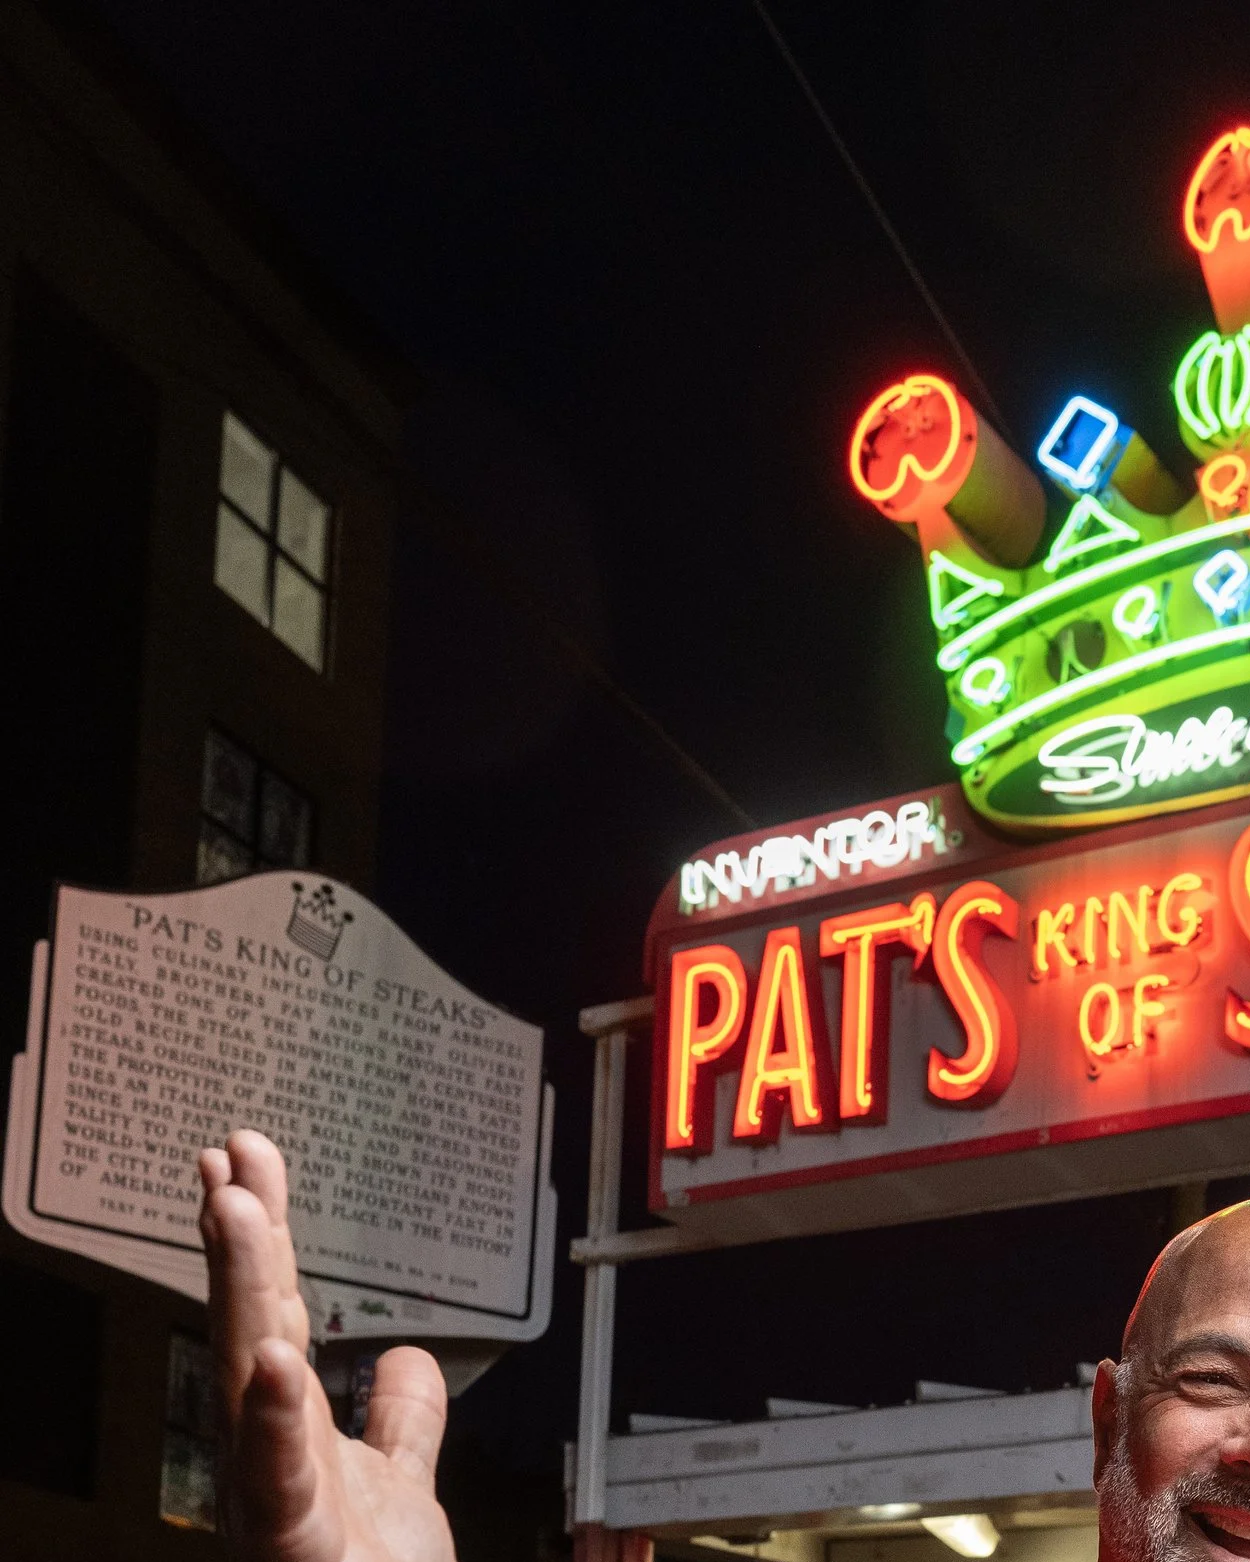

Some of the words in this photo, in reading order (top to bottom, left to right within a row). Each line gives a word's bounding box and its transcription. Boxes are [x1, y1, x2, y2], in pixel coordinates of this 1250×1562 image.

[680, 800, 942, 910] INVENTOR
[235, 934, 312, 981] KING
[322, 960, 363, 995] OF
[1035, 872, 1205, 973] KING
[75, 962, 165, 1001] CREATED
[175, 990, 214, 1015] ONE
[225, 1004, 249, 1024] OF
[261, 1014, 297, 1037] THE
[396, 1051, 475, 1086] FAVORITE
[484, 1076, 523, 1099] FAST
[79, 923, 138, 954] USING
[152, 943, 248, 984] CULINARY
[261, 974, 379, 1020] INFLUENCES
[391, 1010, 440, 1038] FROM
[156, 965, 265, 1009] BROTHERS
[280, 1000, 314, 1023] PAT
[326, 1013, 363, 1037] AND
[377, 1027, 434, 1057] HARRY
[448, 1047, 524, 1082] OLIVIERI
[665, 881, 1018, 1149] PAT'S
[1078, 974, 1170, 1056] OF
[70, 1023, 144, 1055] STEAKS
[153, 1043, 265, 1086] ORIGINATED
[274, 1074, 318, 1099] HERE
[329, 1088, 347, 1107] IN
[399, 1107, 431, 1128] AND
[439, 1117, 520, 1152] INVENTED
[134, 1018, 205, 1050] RECIPE
[218, 1040, 266, 1066] USED
[277, 1056, 296, 1074] IN
[307, 1064, 396, 1100] AMERICAN
[151, 1003, 187, 1026] THE
[197, 1015, 255, 1044] STEAK
[364, 1060, 411, 1086] FROM
[416, 1075, 427, 1090] A
[66, 1081, 122, 1109] SINCE
[319, 1142, 351, 1164] HAS
[361, 1153, 421, 1181] SHOWN
[430, 1170, 457, 1190] ITS
[67, 1060, 116, 1088] USES
[124, 1075, 148, 1096] AN
[310, 1121, 356, 1147] ROLL
[365, 1135, 399, 1157] AND
[69, 1041, 107, 1065] THE
[117, 1053, 224, 1095] PROTOTYPE
[232, 1082, 255, 1102] OF
[263, 1090, 364, 1129] BEEFSTEAK
[371, 1118, 471, 1156] SANDWICHES
[478, 1145, 518, 1168] THAT
[58, 1158, 87, 1179] OF
[100, 1167, 199, 1204] AMERICAN
[61, 1139, 99, 1163] THE
[107, 1150, 150, 1175] CITY
[159, 1163, 183, 1183] OF
[330, 1203, 381, 1228] PLACE
[386, 1216, 403, 1233] IN
[410, 1222, 442, 1242] THE
[450, 1231, 512, 1258] HISTORY
[64, 1099, 131, 1130] TALITY
[142, 1118, 168, 1139] TO
[299, 1156, 335, 1178] AND
[345, 1167, 450, 1206] POLITICIANS
[458, 1195, 514, 1222] KNOWN
[298, 1176, 320, 1194] AN
[332, 1184, 434, 1221] IMPORTANT
[445, 1211, 486, 1234] PART
[496, 1223, 513, 1240] IN
